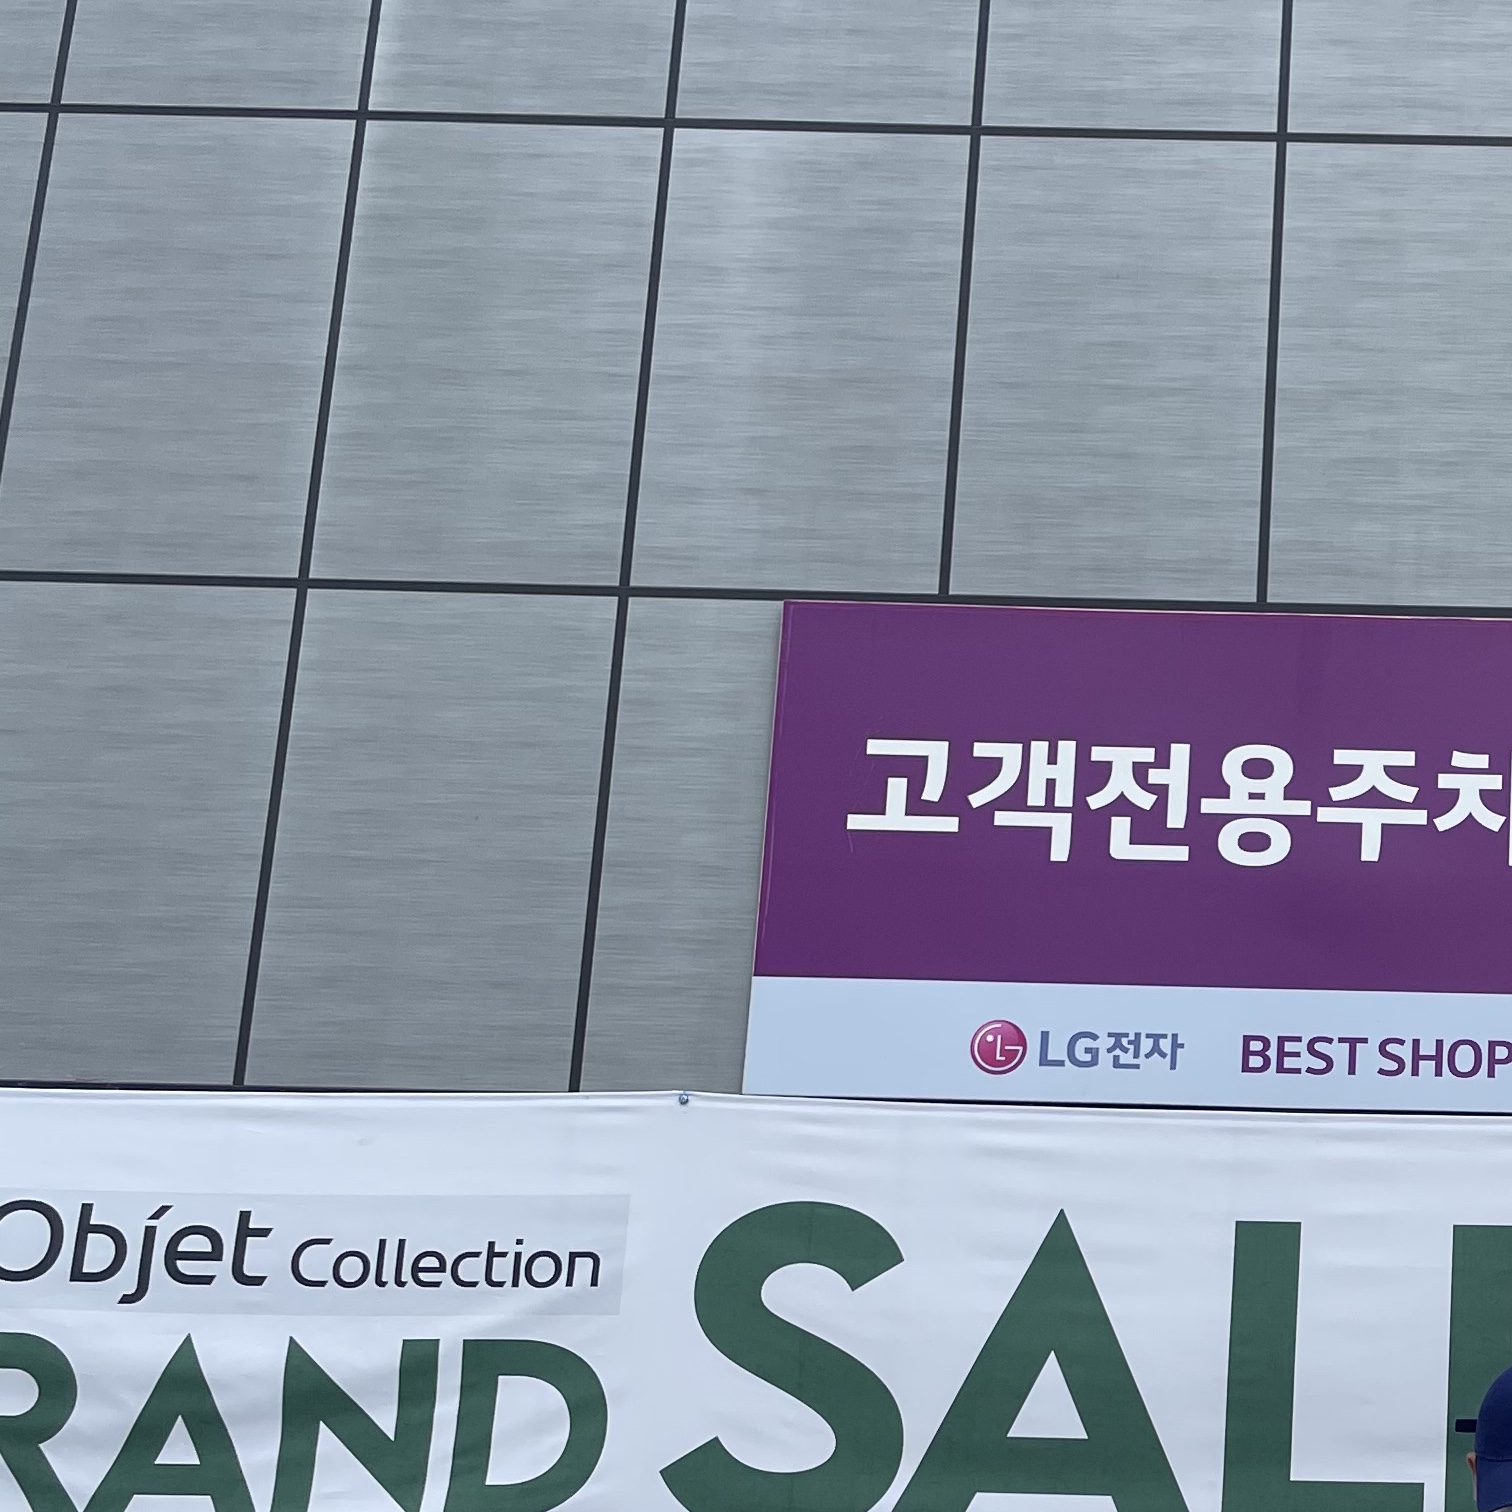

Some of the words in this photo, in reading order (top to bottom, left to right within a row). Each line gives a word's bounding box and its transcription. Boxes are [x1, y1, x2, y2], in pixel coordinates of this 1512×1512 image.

[1038, 1030, 1185, 1071] LG전자
[1241, 1034, 1370, 1077] BEST
[291, 1237, 601, 1289] Collection
